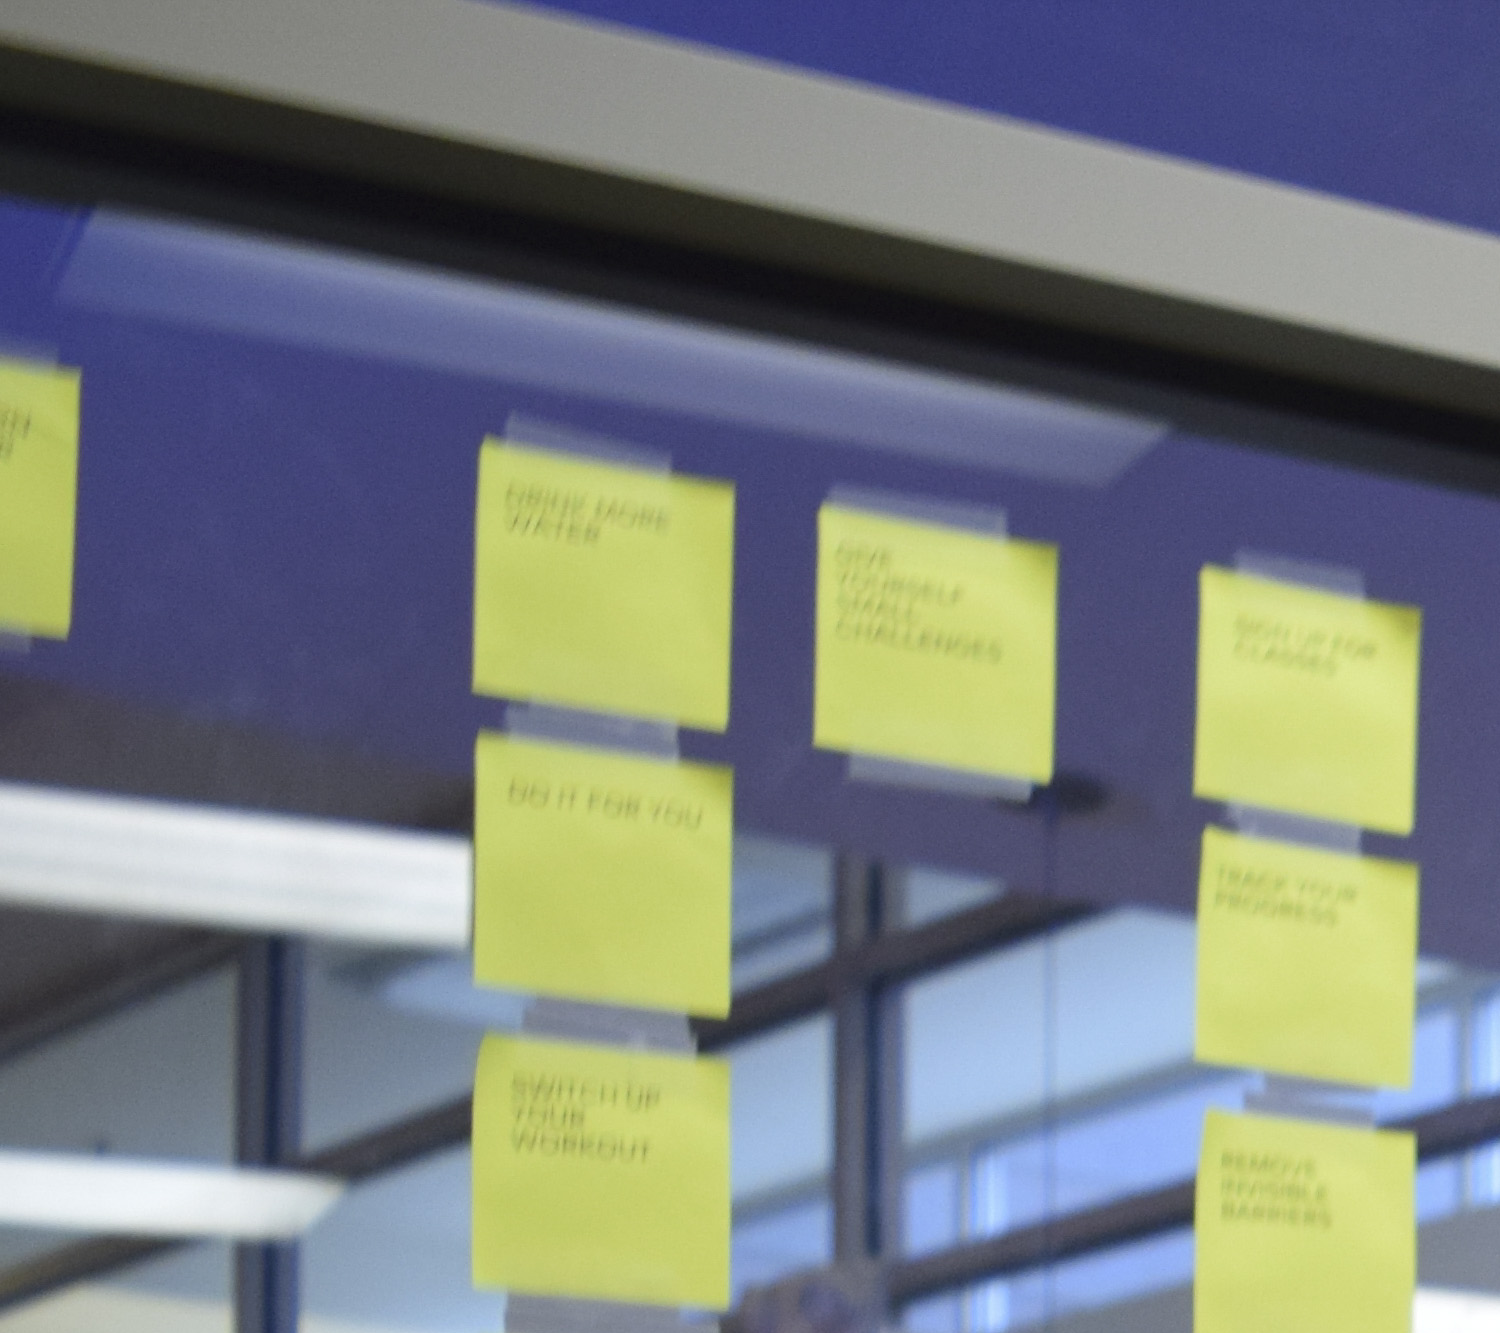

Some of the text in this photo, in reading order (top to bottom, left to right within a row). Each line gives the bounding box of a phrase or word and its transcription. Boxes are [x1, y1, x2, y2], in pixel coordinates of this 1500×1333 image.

[507, 482, 670, 537] DRINK MORE
[507, 512, 602, 547] WATER
[508, 775, 704, 833] DO IT FOR YOU
[511, 1072, 661, 1113] SWITCH UP
[511, 1103, 586, 1131] YOUR
[511, 1130, 651, 1163] WORKOUT
[1221, 1150, 1315, 1180] REMOVE
[1221, 1177, 1327, 1204] INVISIBLE
[1221, 1202, 1332, 1231] BARRIERS
